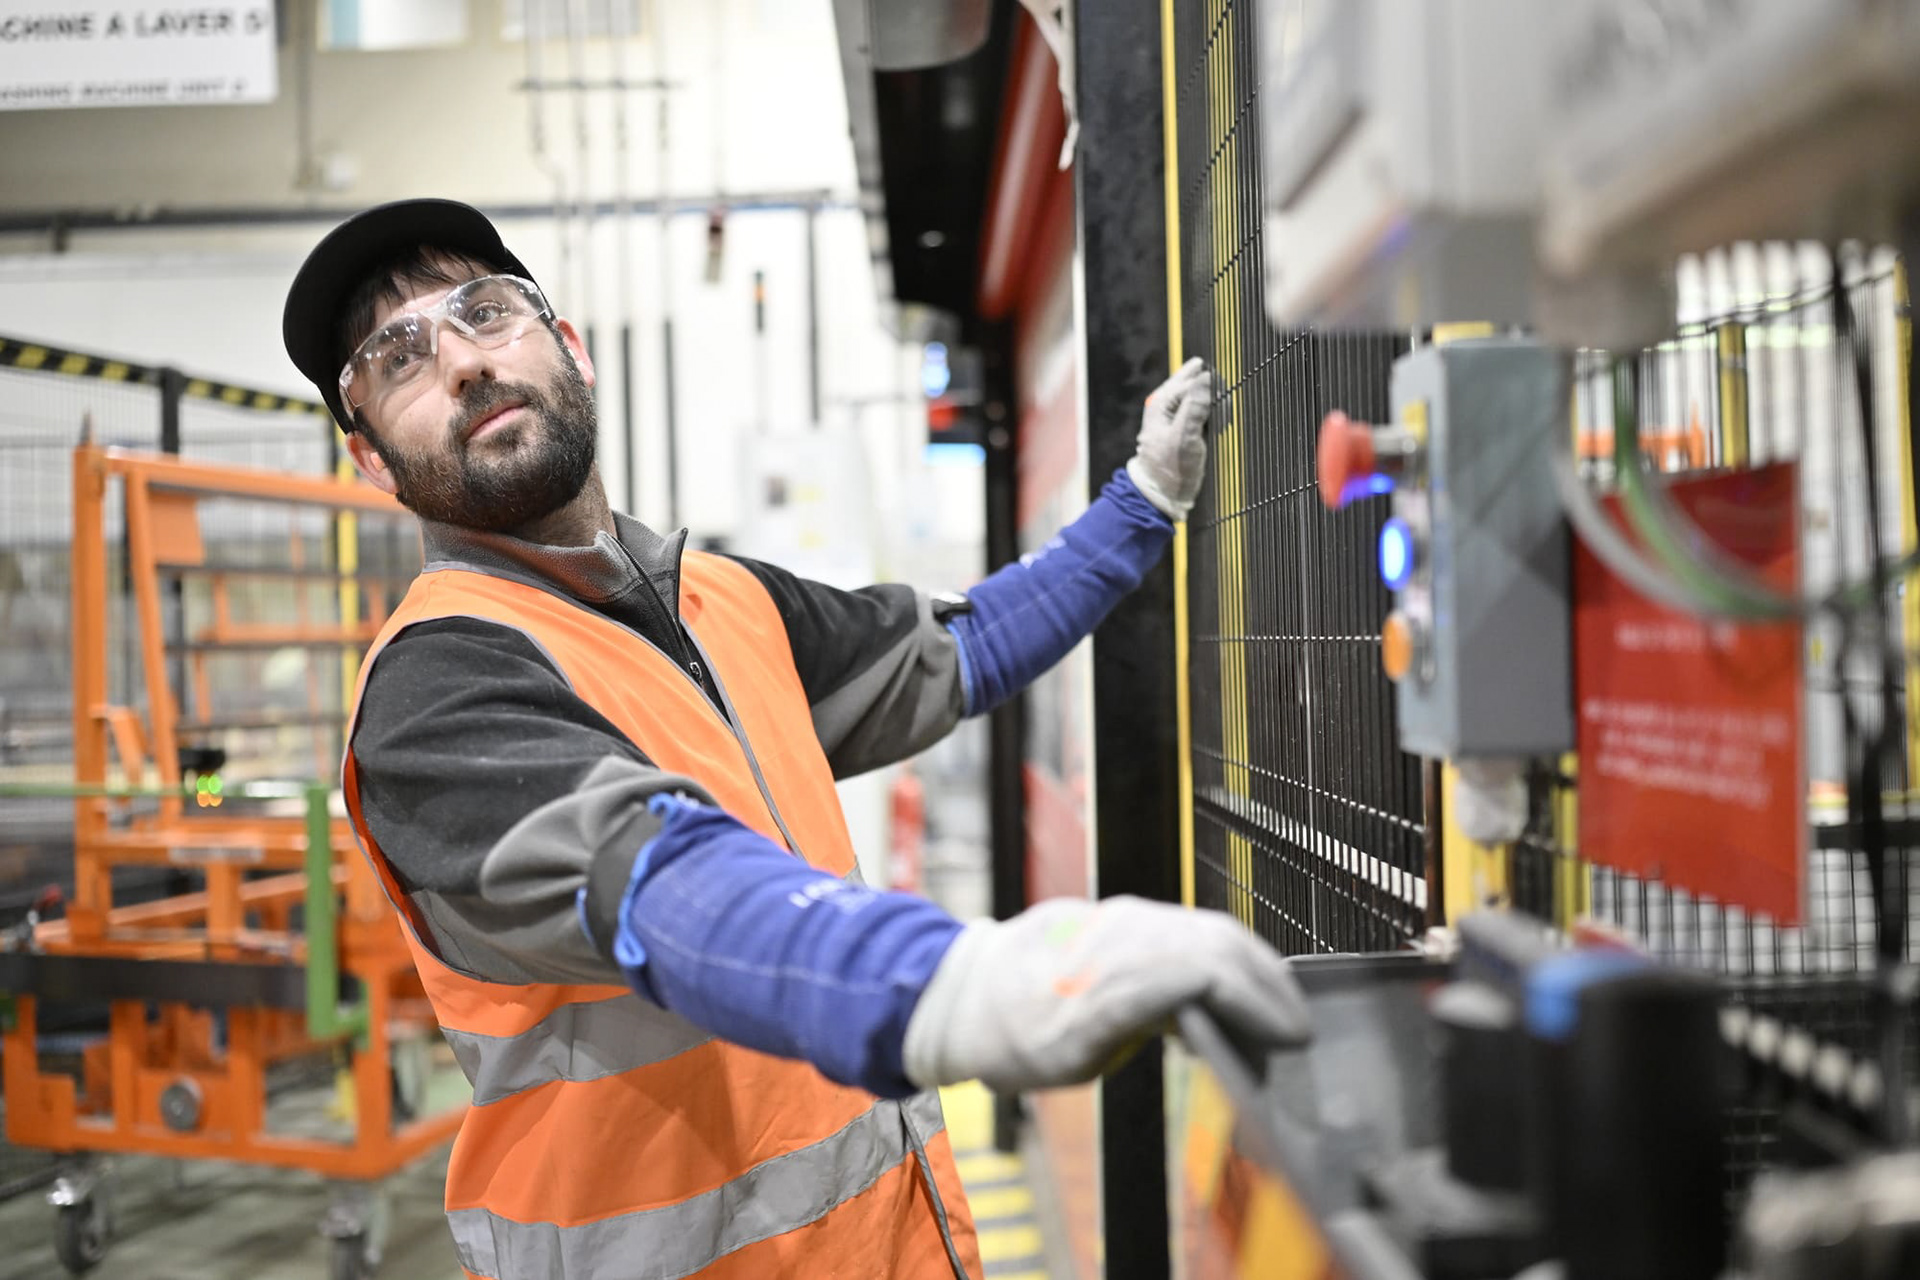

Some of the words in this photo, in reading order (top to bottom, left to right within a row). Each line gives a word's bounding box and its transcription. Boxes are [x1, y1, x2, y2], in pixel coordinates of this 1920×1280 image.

[0, 14, 94, 44] CHINE
[104, 12, 127, 38] A
[133, 9, 237, 38] LAVER
